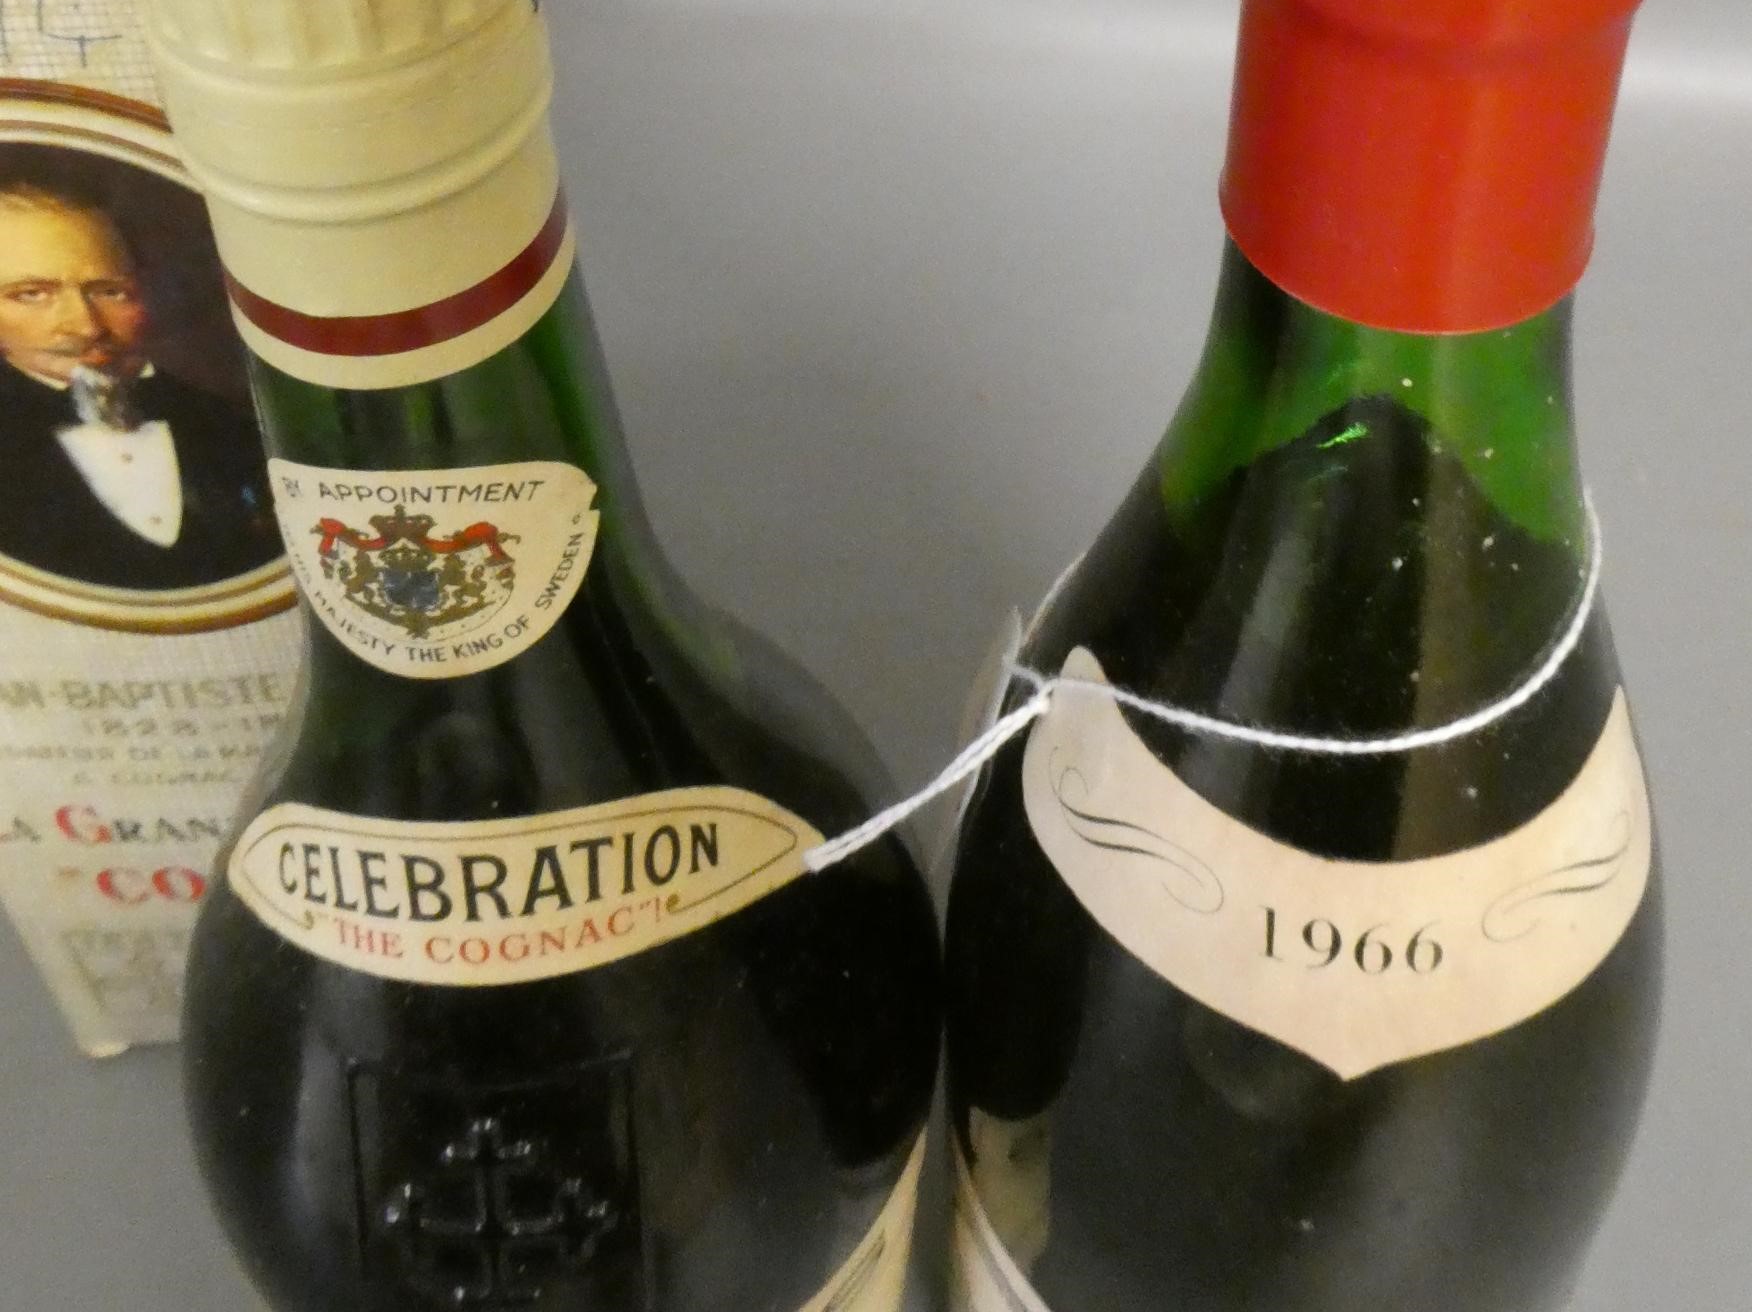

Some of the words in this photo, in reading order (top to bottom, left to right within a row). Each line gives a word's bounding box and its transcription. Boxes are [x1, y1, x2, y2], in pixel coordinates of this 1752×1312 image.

[319, 481, 545, 504] APPOINTMENT
[313, 590, 396, 656] MAJESTY
[405, 646, 448, 664] THE
[453, 630, 504, 659] KING
[503, 615, 531, 640] OF
[535, 532, 584, 611] SWEDEN
[278, 823, 720, 923] CELEBRATION
[1260, 905, 1443, 975] 1966
